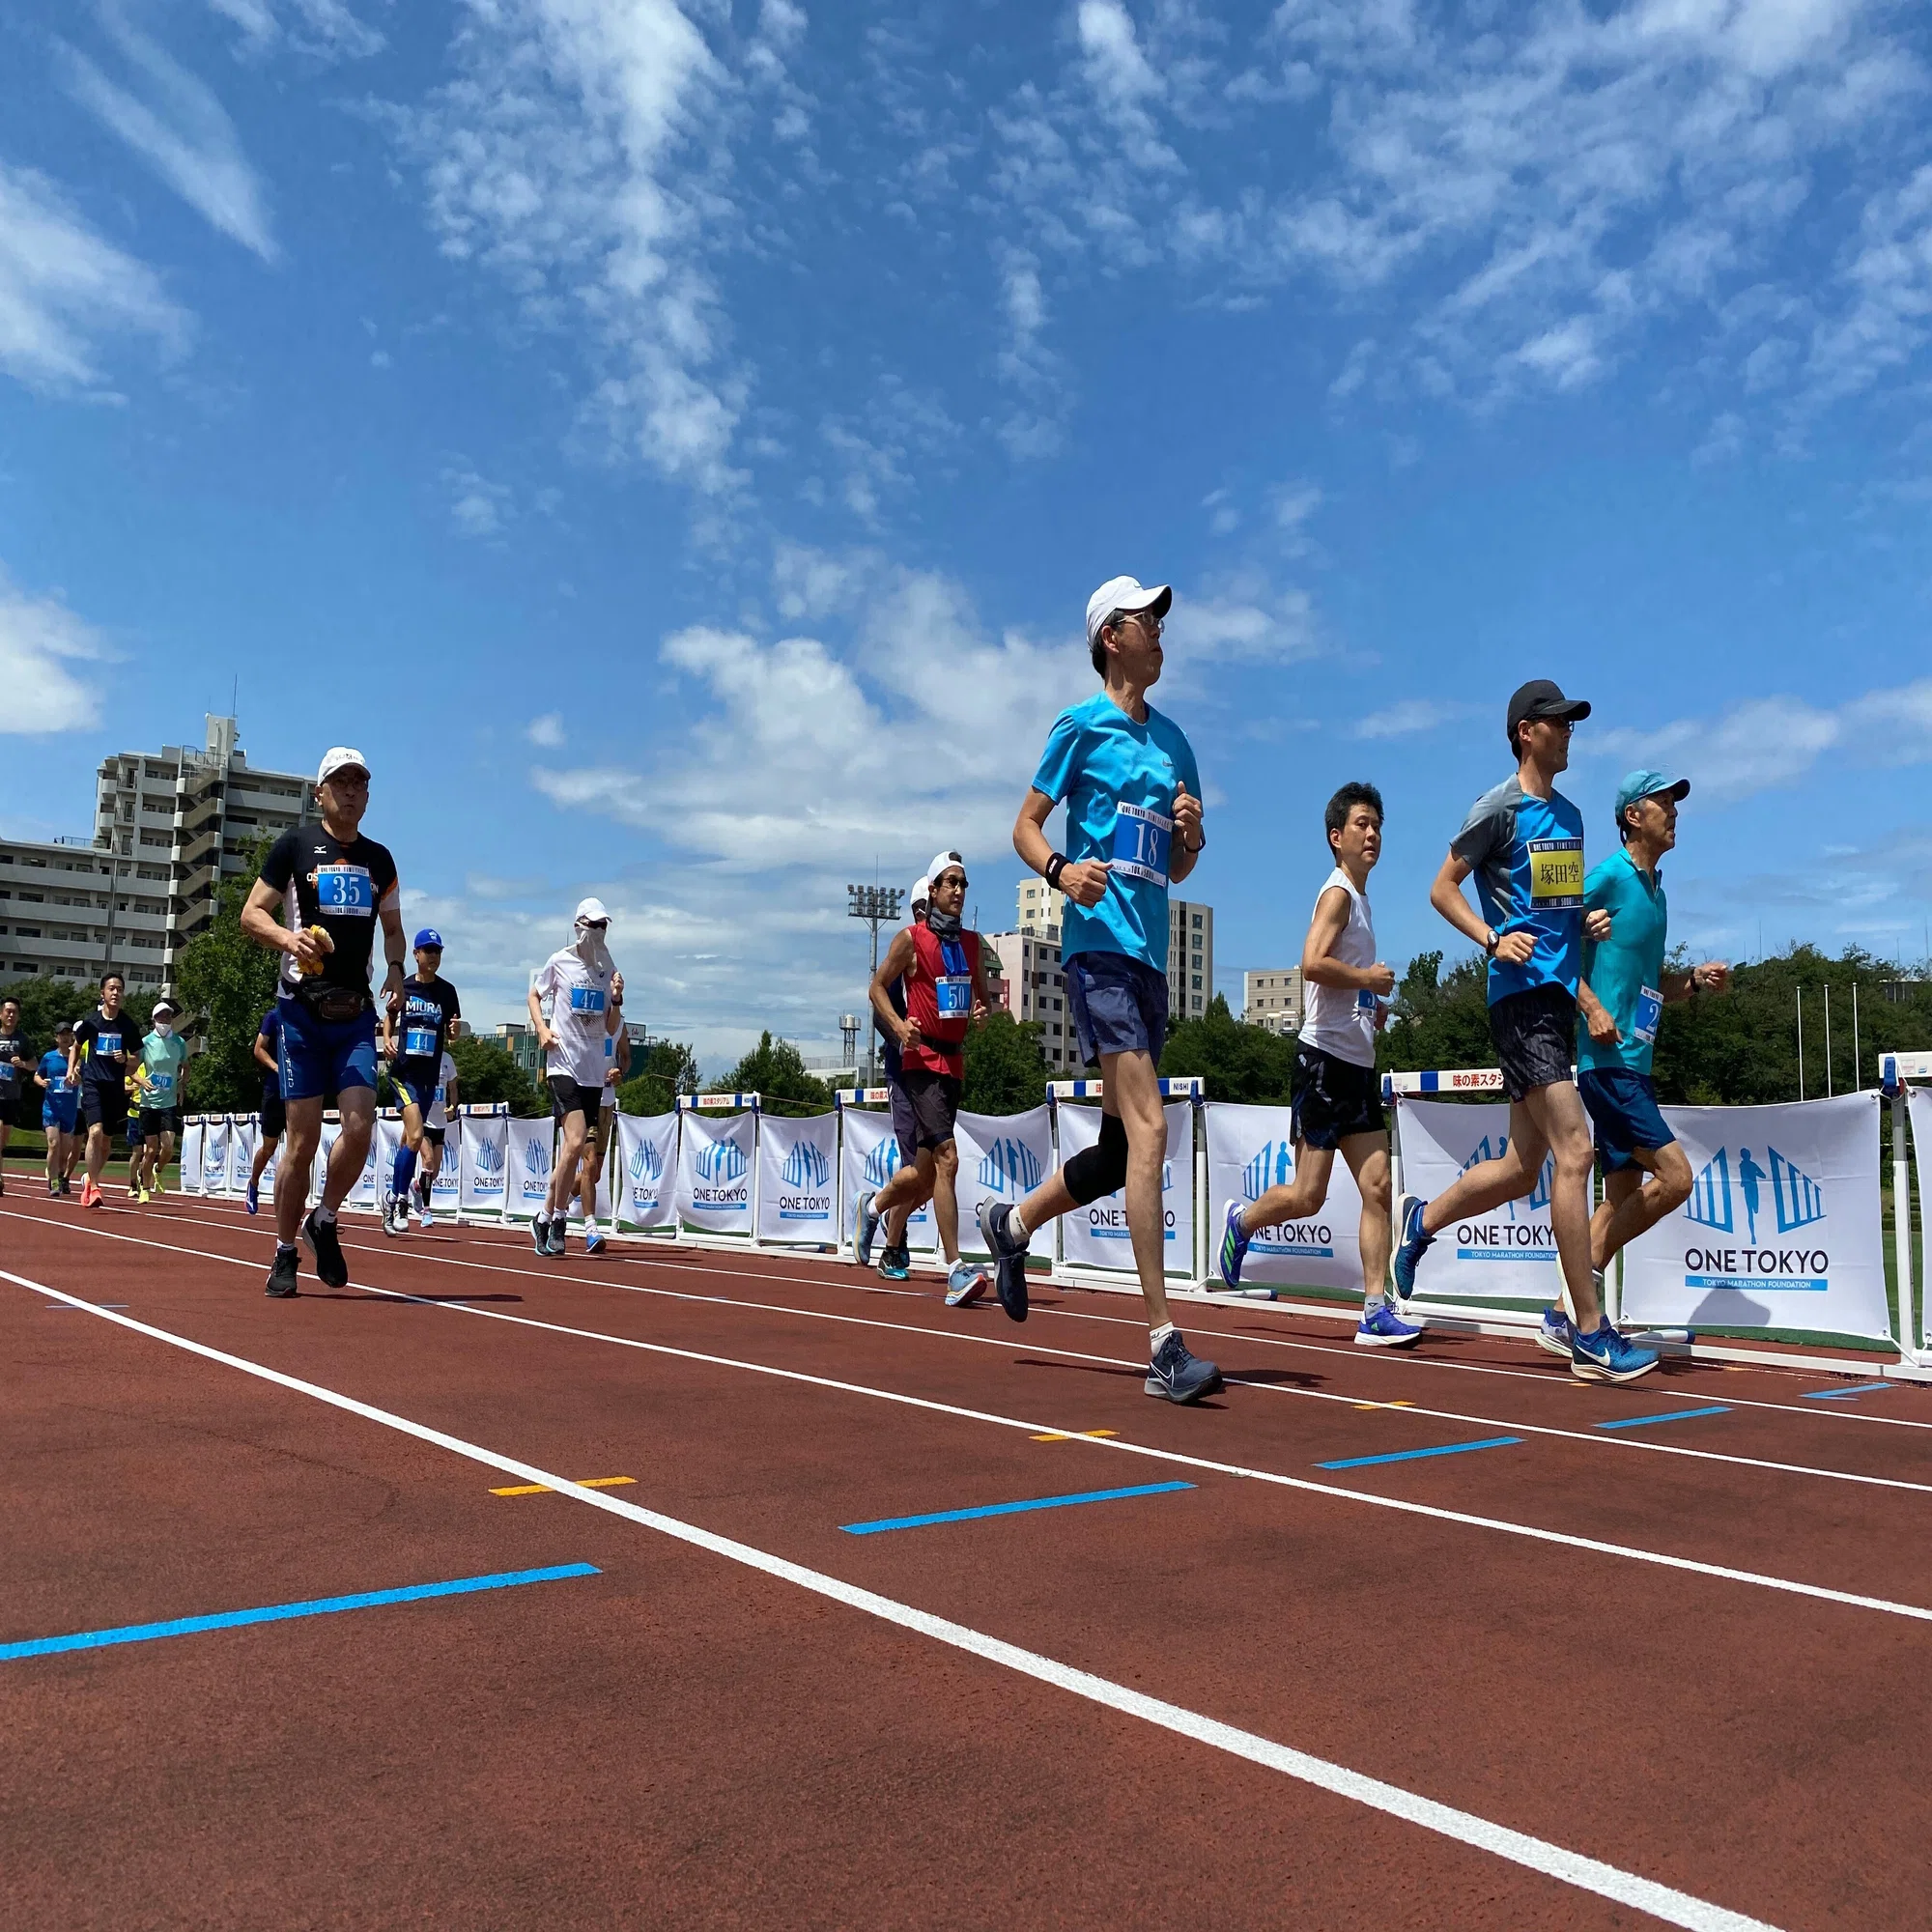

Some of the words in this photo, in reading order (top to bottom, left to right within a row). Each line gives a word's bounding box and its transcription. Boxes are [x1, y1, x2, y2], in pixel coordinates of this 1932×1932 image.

[1132, 823, 1158, 867] 18
[332, 875, 360, 905] 35
[580, 991, 597, 1009] 47
[949, 985, 965, 1009] 50
[406, 999, 443, 1015] MIURA
[412, 1034, 429, 1051] 44
[1173, 1082, 1189, 1091] NISHI
[473, 1177, 489, 1187] ONE
[693, 1187, 711, 1202] ONE
[712, 1188, 748, 1202] TOKYO
[780, 1196, 802, 1210] ONE
[803, 1197, 831, 1210] TOKYO
[1089, 1208, 1120, 1227] ONE
[1256, 1226, 1272, 1241] NE
[1273, 1224, 1332, 1244] TOKYO
[1457, 1224, 1500, 1245] ONE
[1503, 1225, 1554, 1246] TOKY
[1685, 1247, 1738, 1273] ONE
[1742, 1249, 1829, 1274] TOKYO
[1702, 1278, 1727, 1287] TOKYO
[1727, 1279, 1767, 1288] MARATHON
[1768, 1280, 1811, 1289] FOUNDATION
